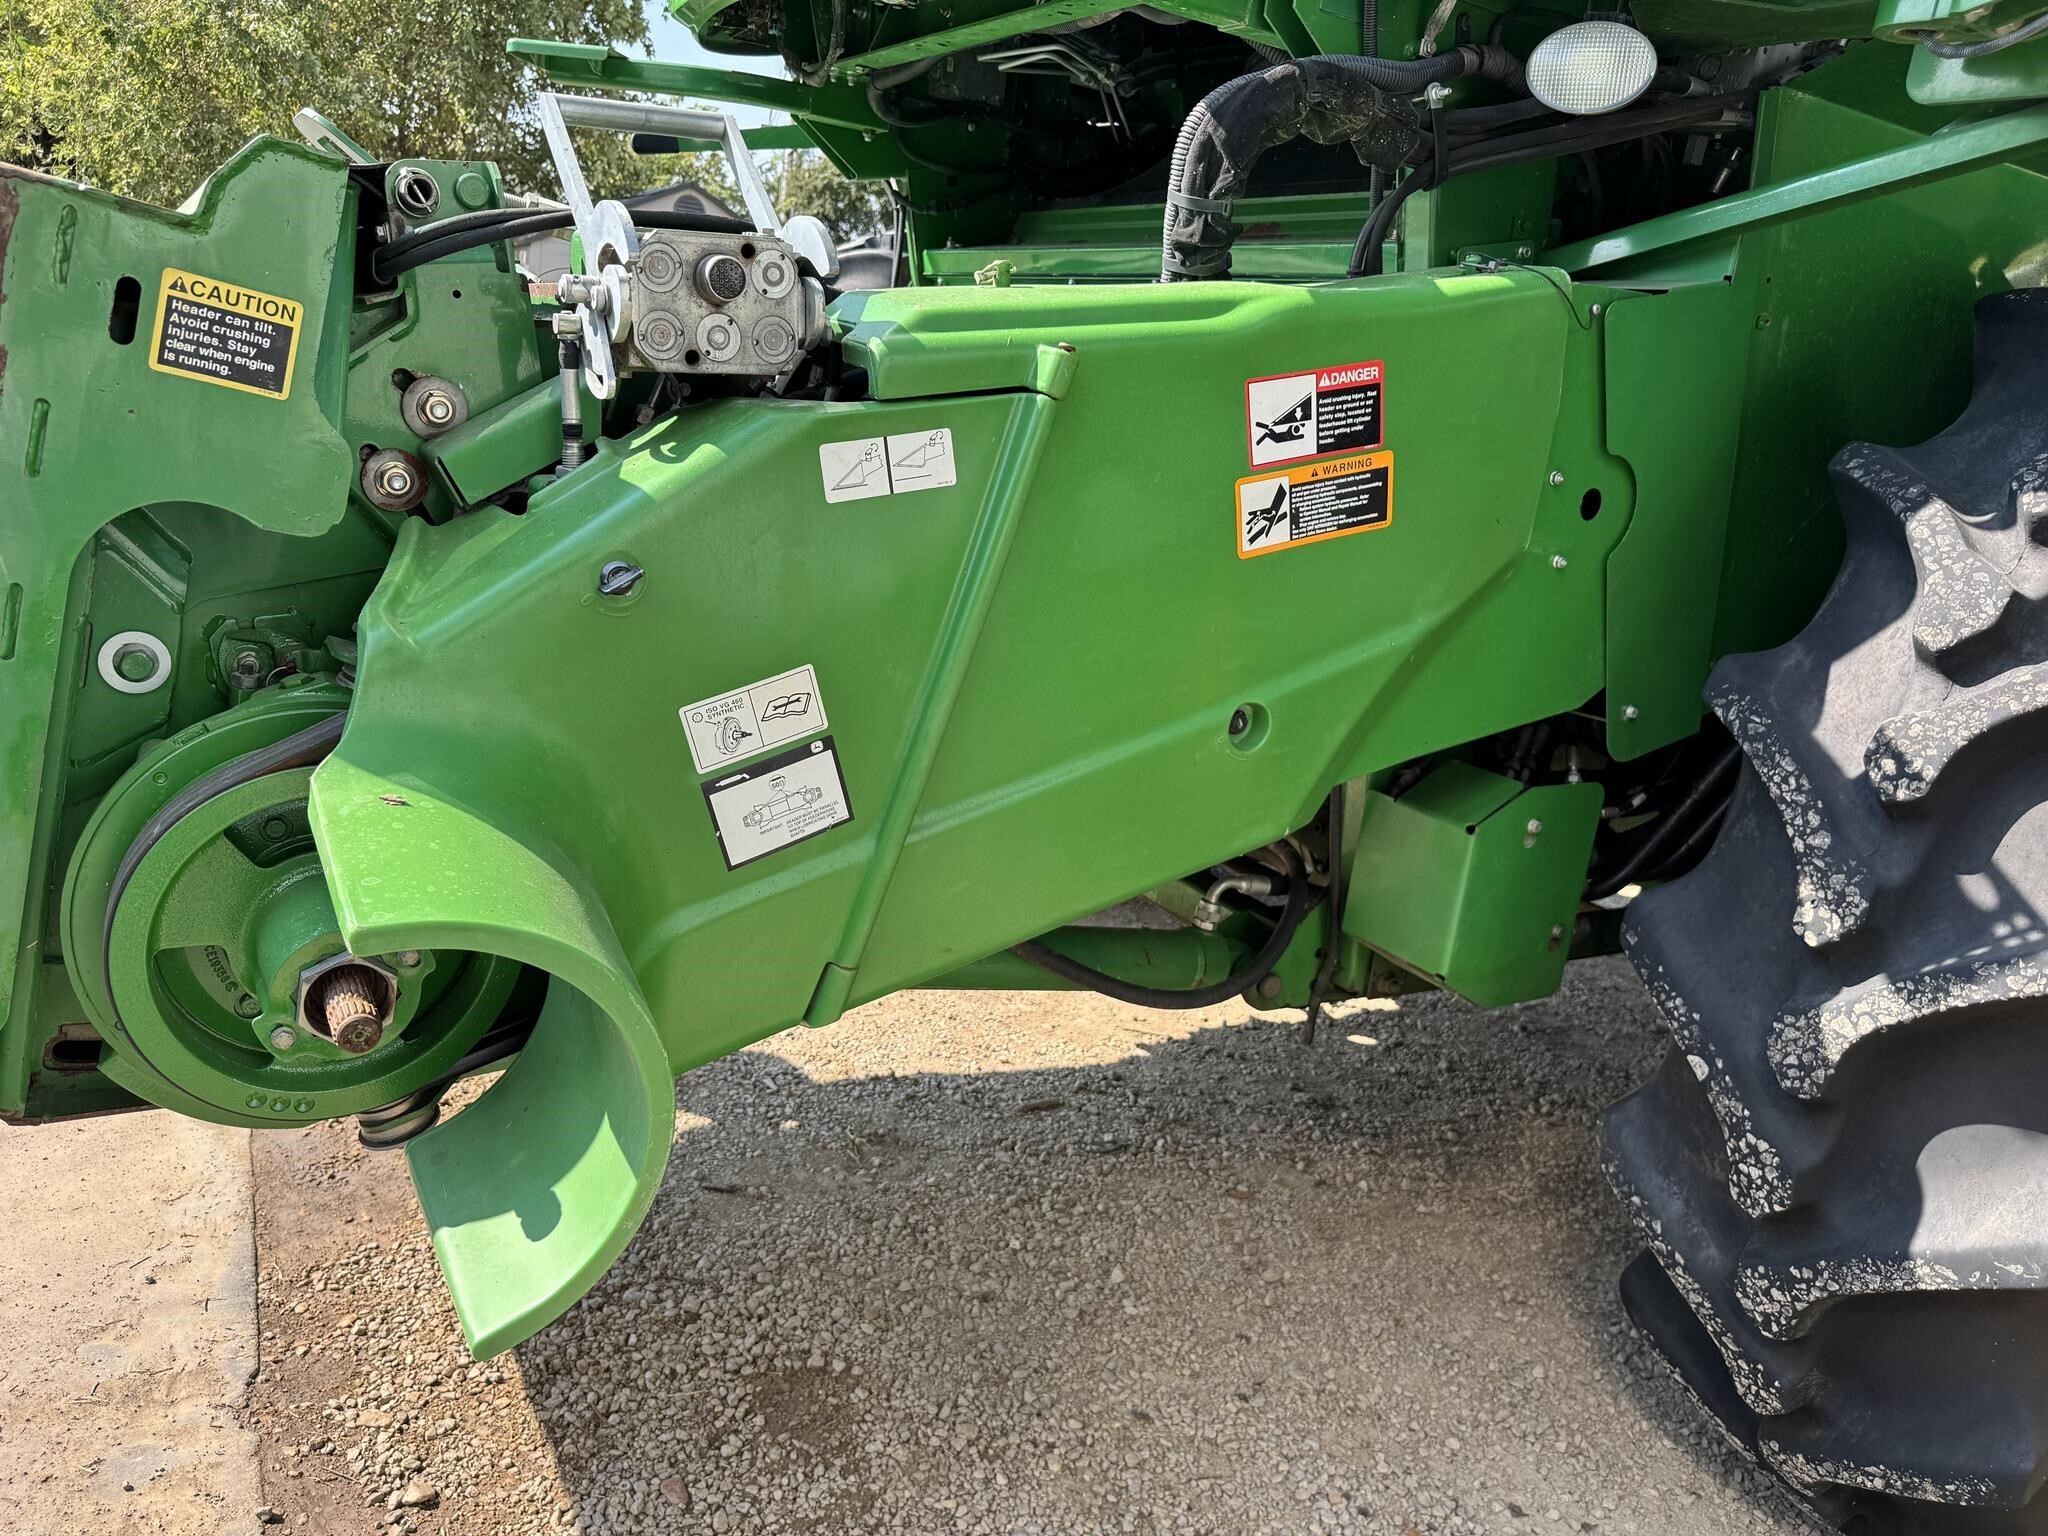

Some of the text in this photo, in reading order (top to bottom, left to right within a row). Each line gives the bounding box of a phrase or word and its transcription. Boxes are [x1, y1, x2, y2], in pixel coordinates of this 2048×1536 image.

[190, 280, 296, 322] CAUTION
[169, 312, 271, 349] Avoid crushing
[172, 299, 276, 336] Header can tilt.
[165, 338, 275, 373] clear when engine
[167, 324, 257, 357] injuries. Stay
[163, 349, 232, 376] is running.
[1331, 366, 1379, 384] DANGER
[1322, 458, 1372, 474] WARNING
[704, 705, 718, 715] ISO
[718, 701, 730, 711] VG
[707, 703, 745, 721] SYNTHETIC
